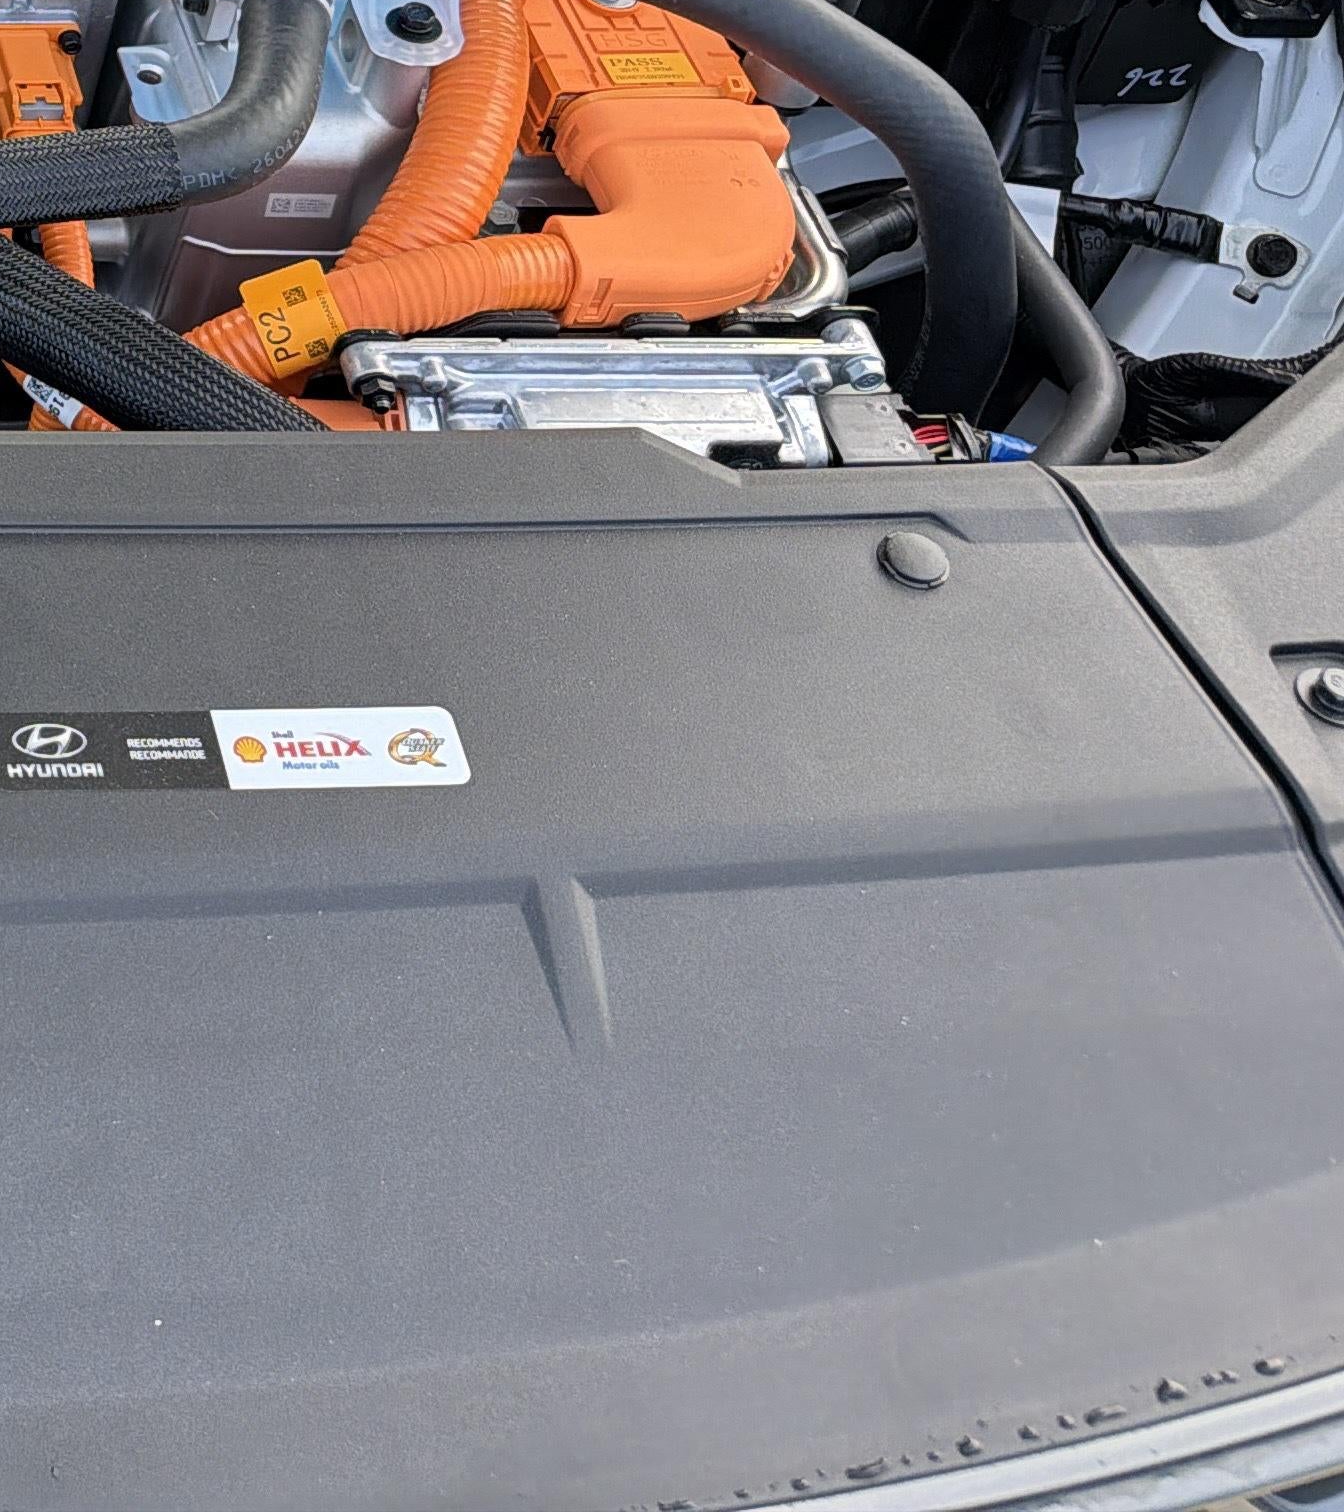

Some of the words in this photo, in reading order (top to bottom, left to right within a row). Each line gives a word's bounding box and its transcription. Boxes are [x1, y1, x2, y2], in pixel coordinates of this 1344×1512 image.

[600, 32, 667, 48] HSG
[608, 57, 664, 67] PASS
[258, 307, 303, 364] PC2
[271, 730, 294, 739] Shell
[126, 737, 203, 749] RECOMMENDS
[273, 735, 373, 758] HELIX
[129, 750, 206, 761] RECOMMANDE
[6, 762, 105, 778] HYUNDAI
[282, 760, 317, 771] Motor
[319, 759, 340, 770] oils
